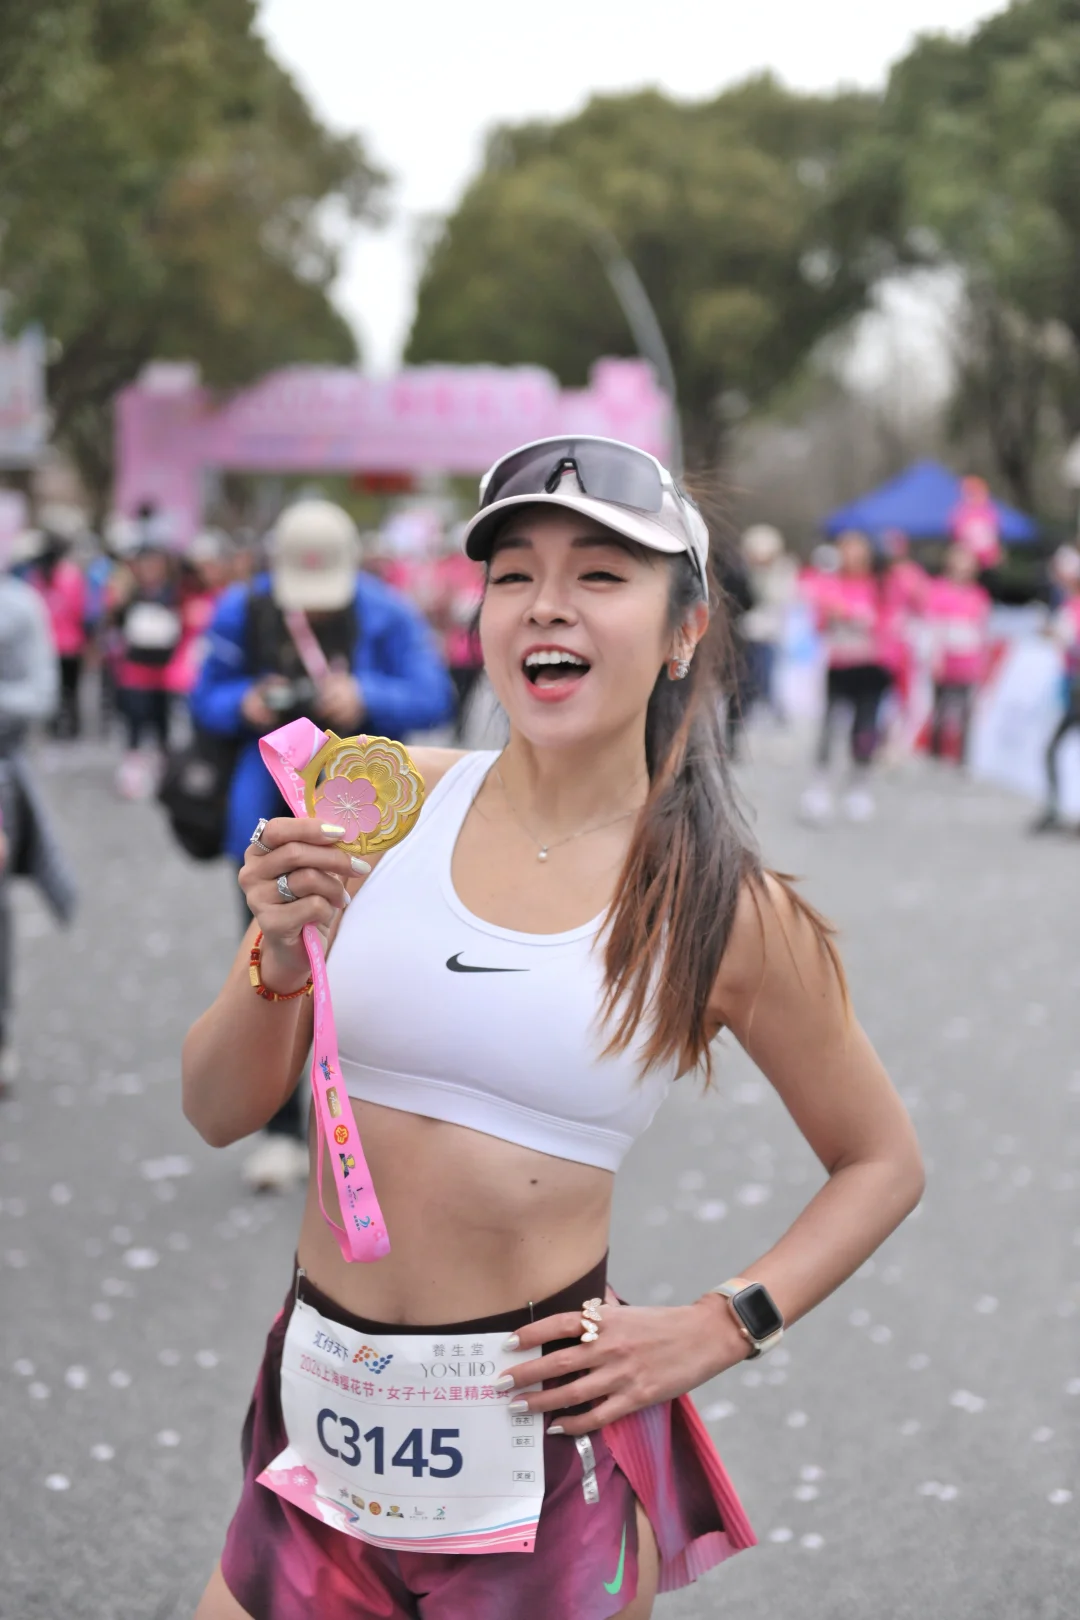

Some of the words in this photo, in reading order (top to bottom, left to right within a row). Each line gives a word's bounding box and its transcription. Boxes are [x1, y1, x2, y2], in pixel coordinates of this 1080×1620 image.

[313, 1330, 349, 1361] 汇付天下
[432, 1343, 485, 1357] 養生堂
[420, 1360, 496, 1378] YOSEIDO
[316, 1408, 464, 1479] C3145
